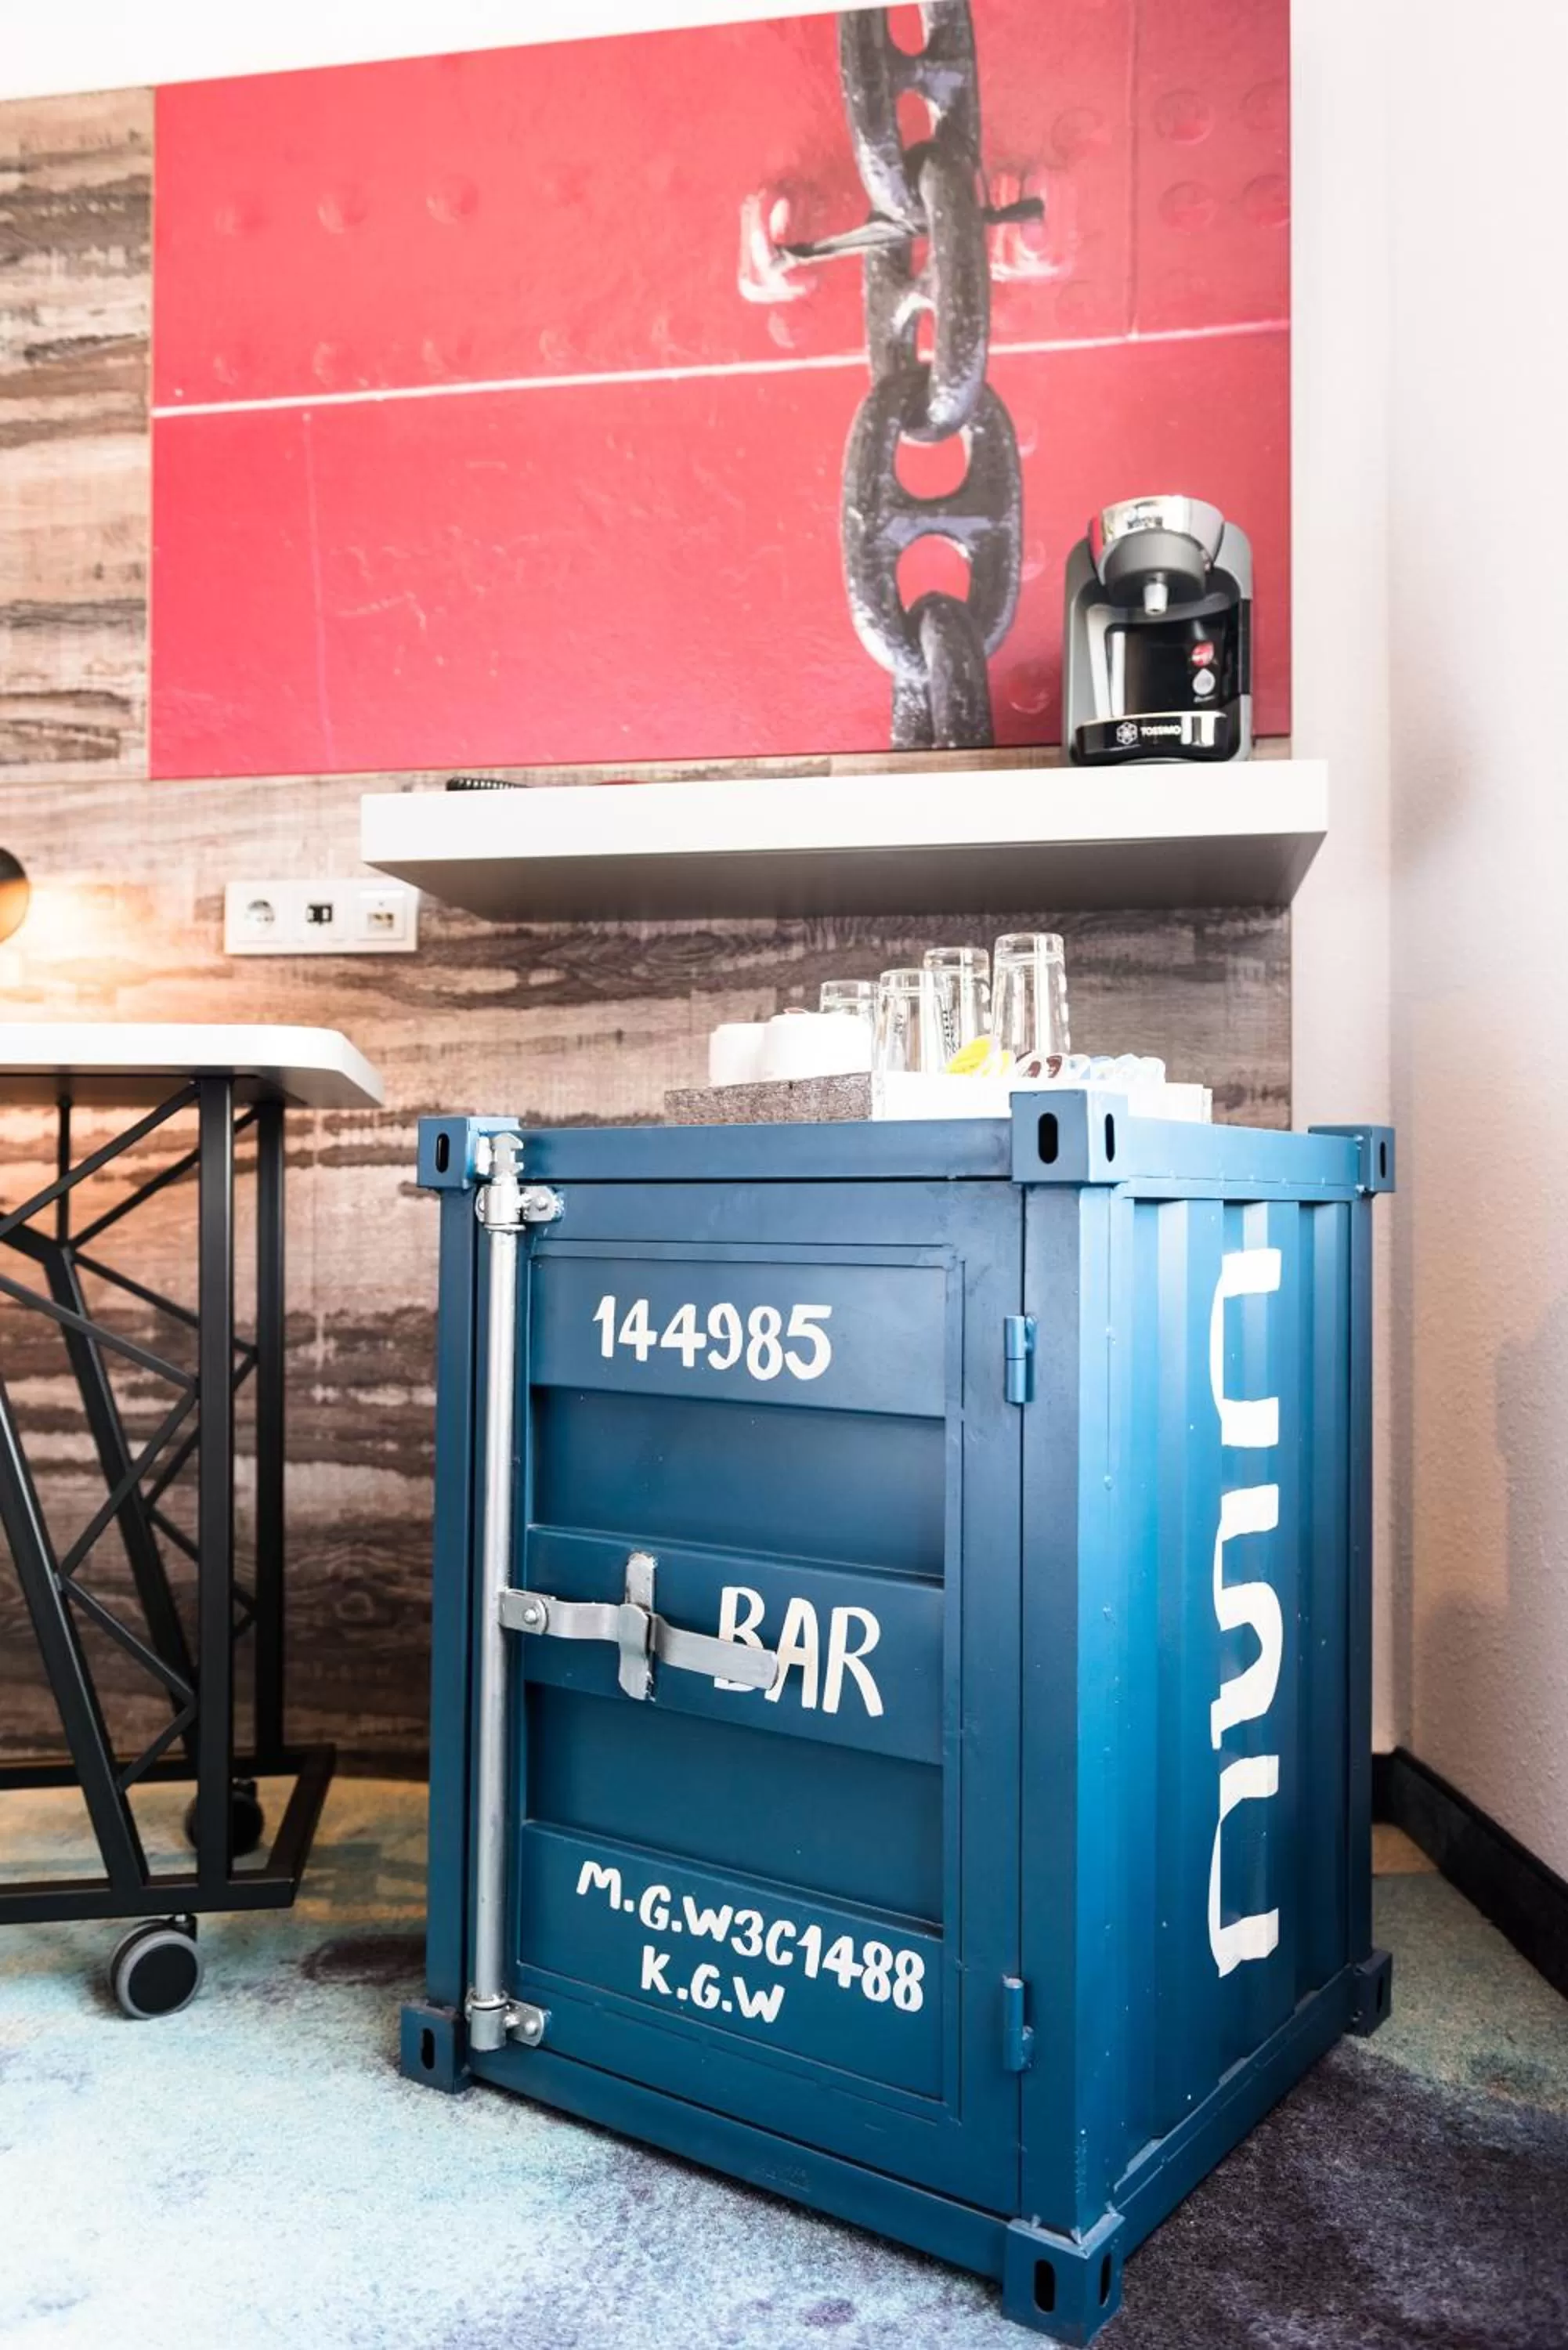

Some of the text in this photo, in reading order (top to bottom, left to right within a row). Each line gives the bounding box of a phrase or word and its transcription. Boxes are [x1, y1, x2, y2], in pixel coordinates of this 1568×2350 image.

[593, 1296, 833, 1381] 144985
[714, 1586, 883, 1717] BAR
[641, 1945, 785, 2023] K.G.W
